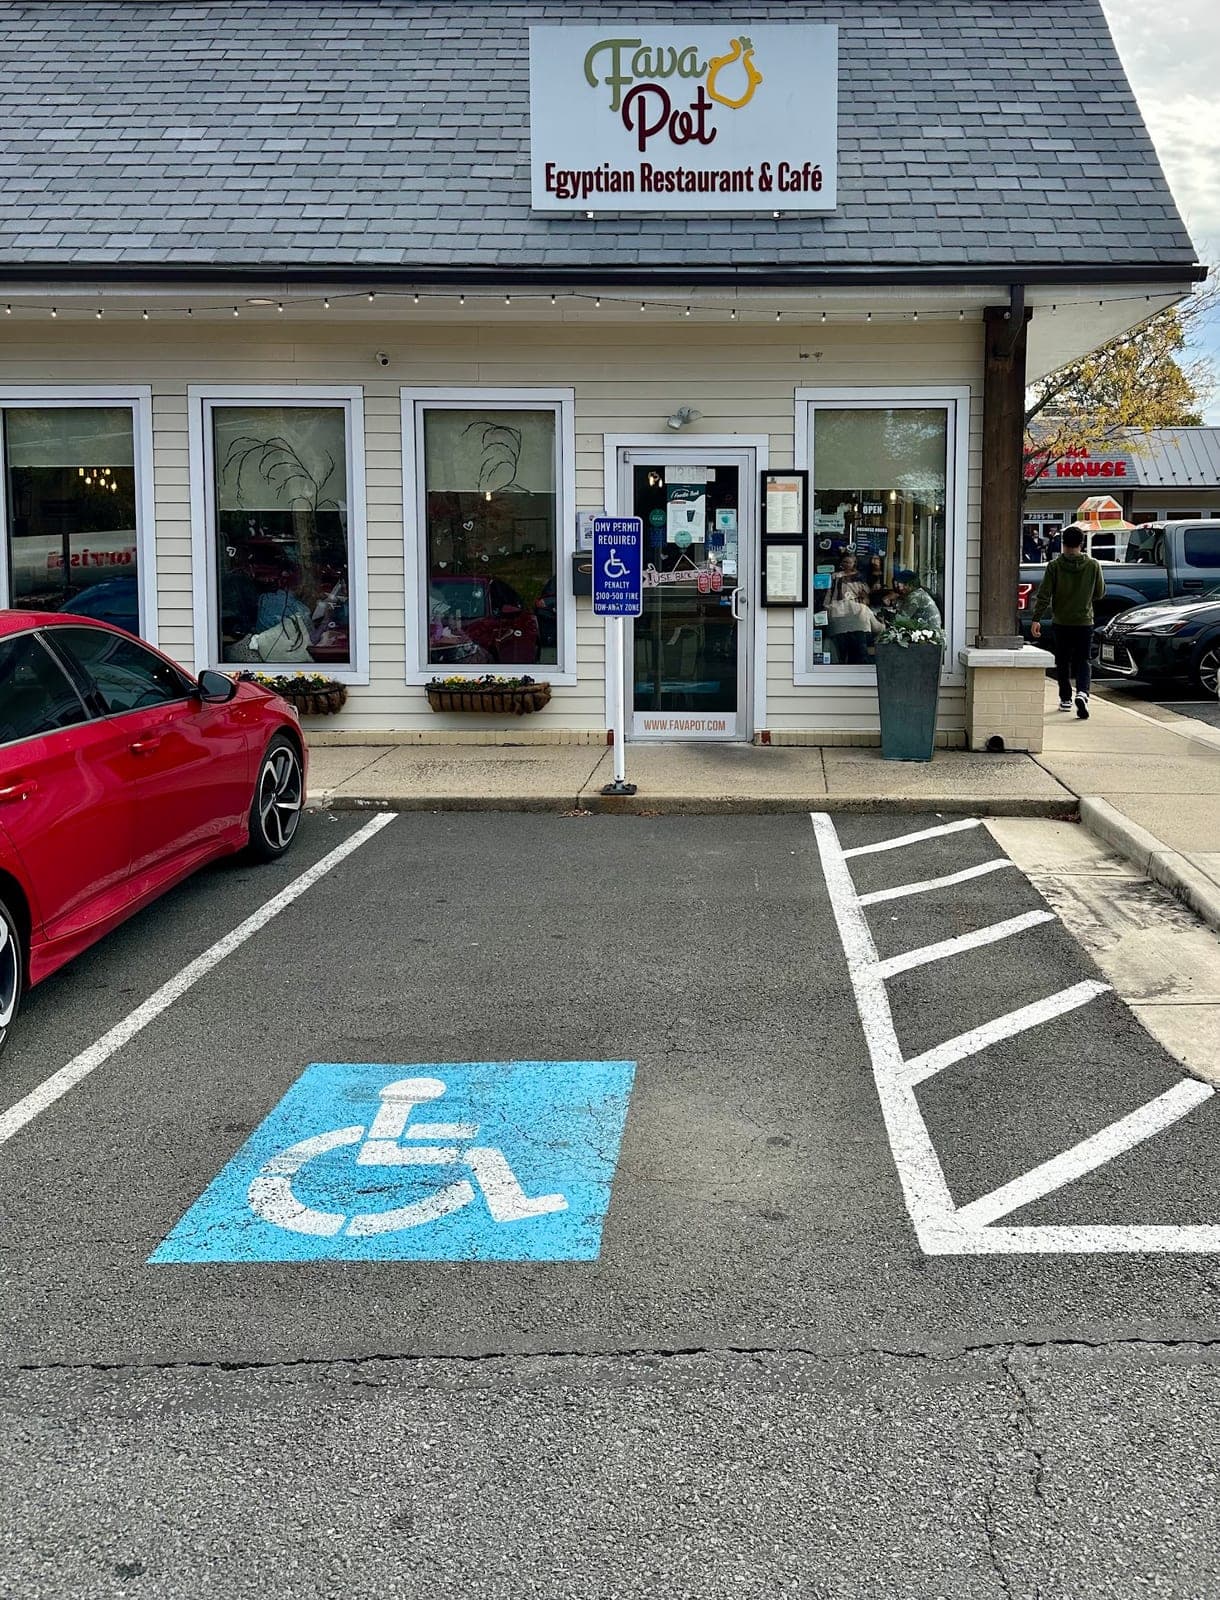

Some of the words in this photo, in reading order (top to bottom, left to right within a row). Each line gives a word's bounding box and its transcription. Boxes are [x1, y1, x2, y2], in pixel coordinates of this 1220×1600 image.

[584, 38, 707, 112] Fava
[622, 83, 717, 152] Pot
[545, 162, 634, 199] Egyptian
[640, 162, 754, 193] Restaurant
[758, 162, 773, 193] &
[777, 161, 823, 193] Café
[1056, 461, 1127, 477] HOUSE
[862, 505, 883, 514] OPEN
[595, 522, 611, 532] DMV
[612, 522, 640, 532] PERMIT
[598, 534, 637, 545] REQUIRED
[604, 581, 630, 589] PENALTY
[595, 592, 624, 601] $100-500
[625, 592, 639, 600] FINE
[594, 603, 624, 611] TOW-AWAY
[625, 603, 640, 611] ZONE
[643, 719, 726, 731] WWW.FAVAPOT.COM
